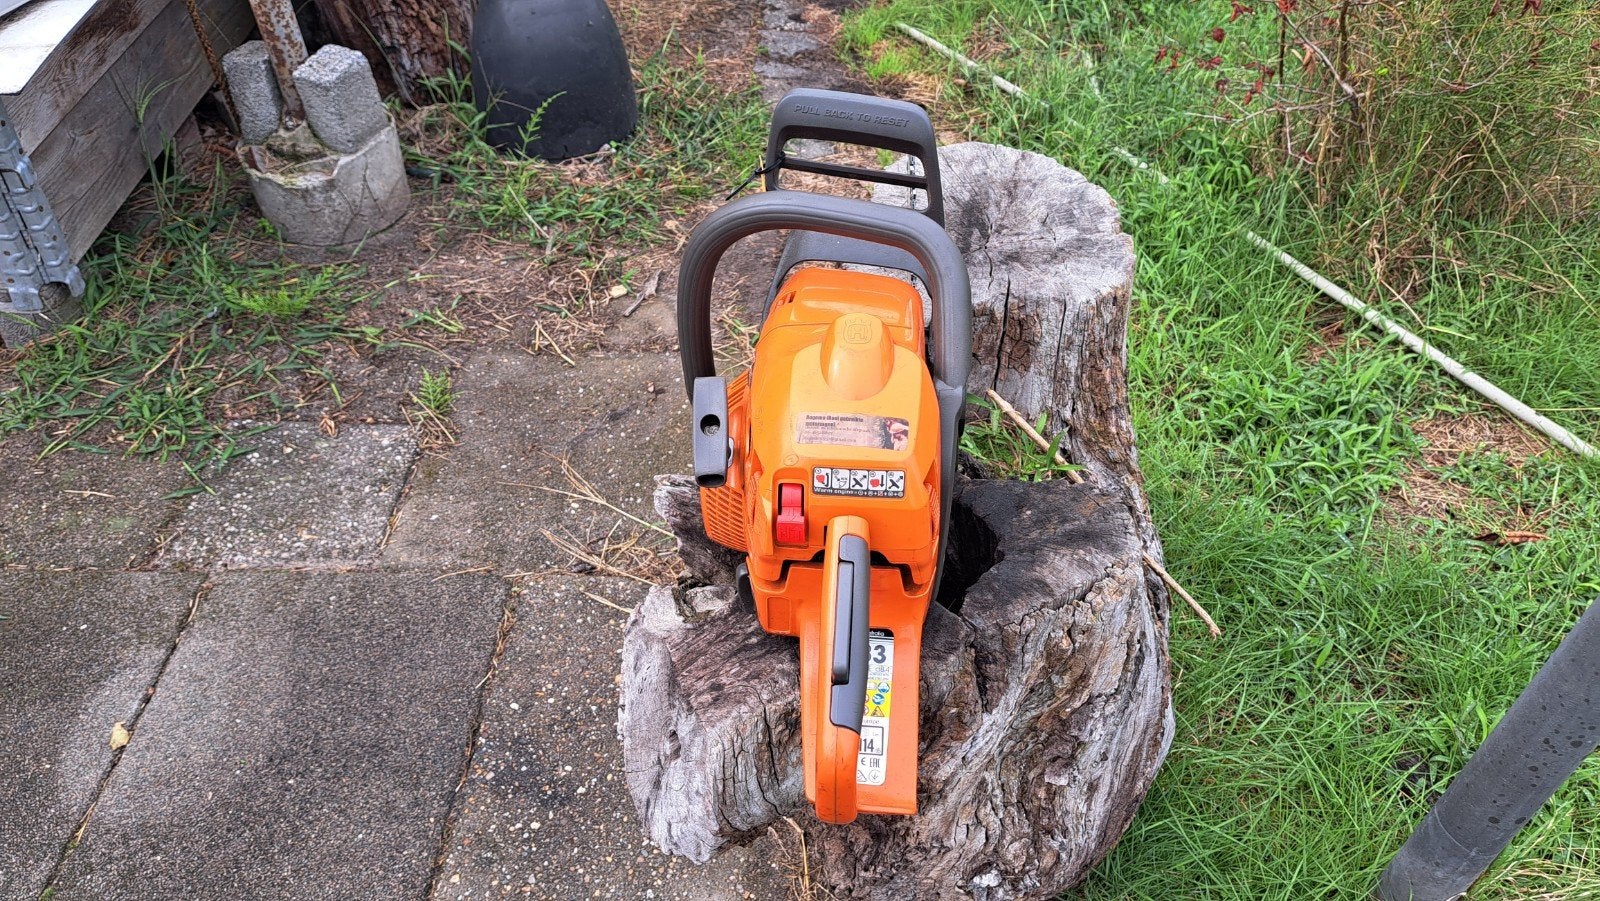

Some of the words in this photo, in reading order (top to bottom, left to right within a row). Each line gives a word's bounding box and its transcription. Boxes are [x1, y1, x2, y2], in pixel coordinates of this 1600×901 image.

[793, 103, 821, 116] PULL
[824, 109, 854, 121] BACK
[857, 113, 872, 123] TO
[873, 115, 910, 128] RESET
[868, 644, 887, 664] 3
